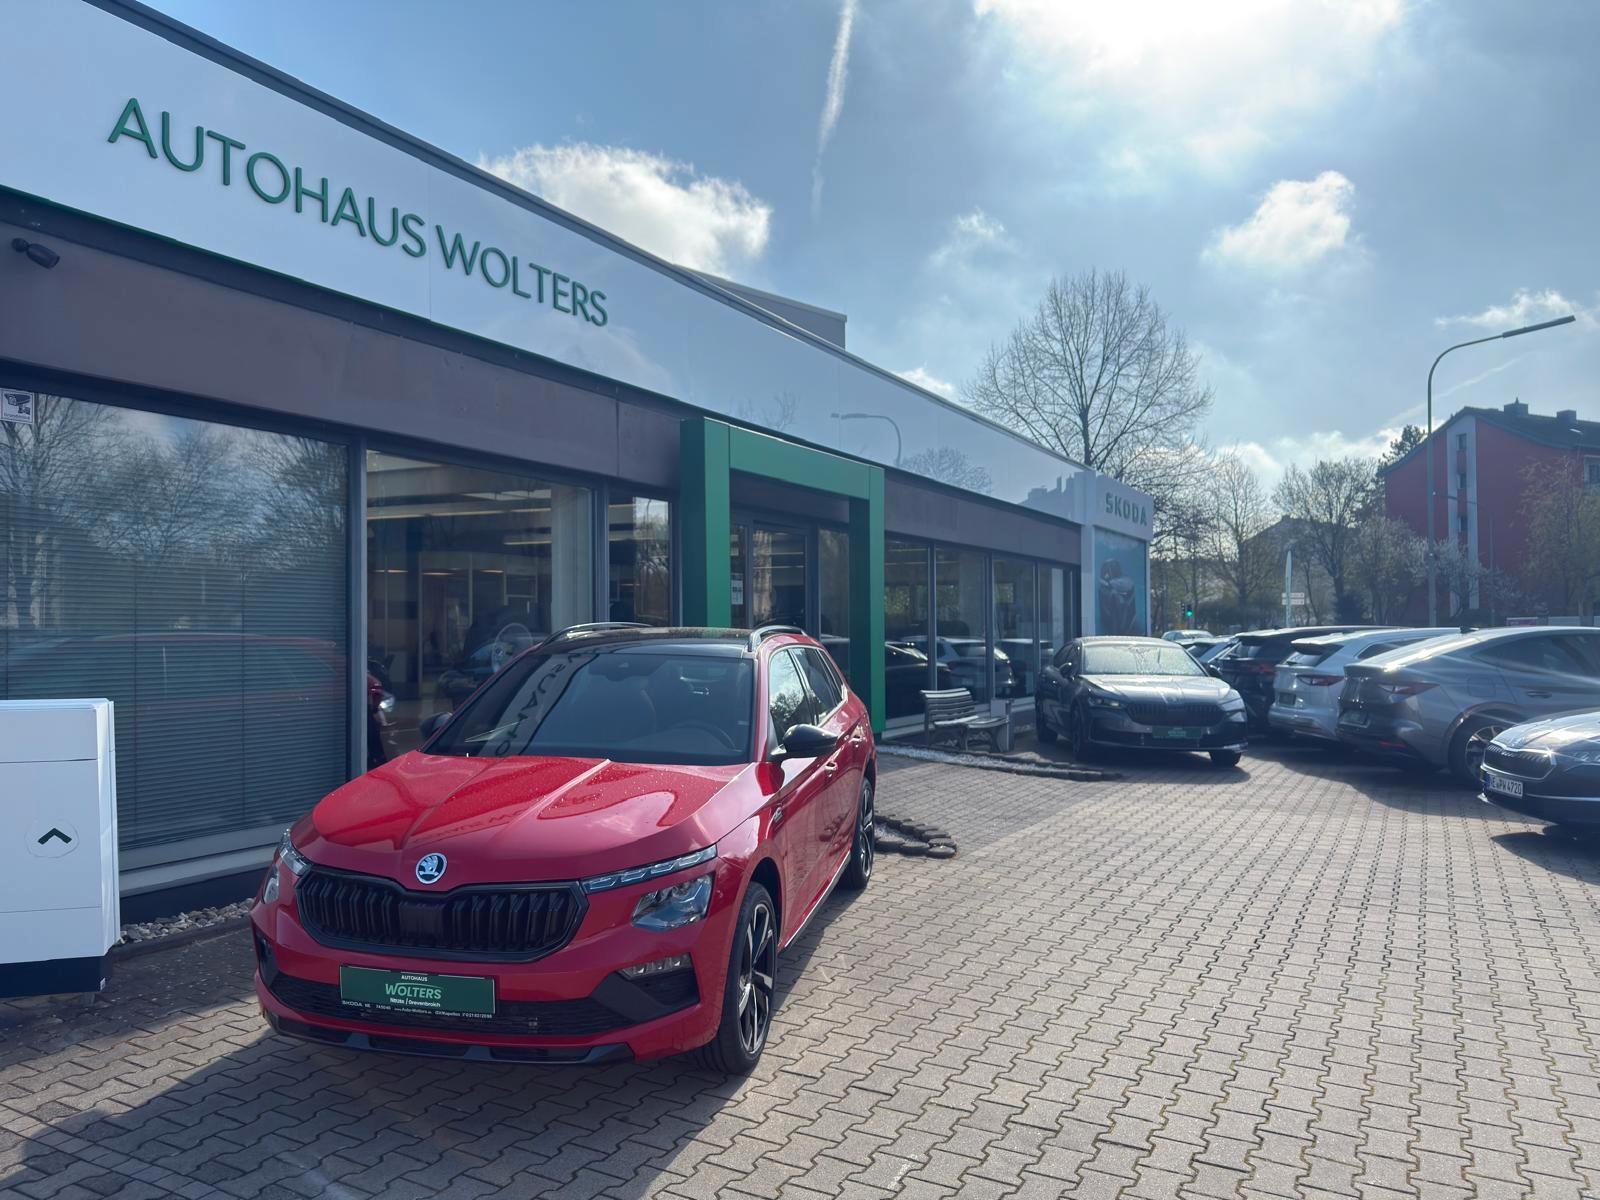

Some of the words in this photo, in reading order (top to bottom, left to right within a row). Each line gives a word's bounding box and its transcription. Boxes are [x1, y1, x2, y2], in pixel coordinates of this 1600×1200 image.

[107, 97, 427, 258] AUTOHAUS
[435, 224, 609, 327] WOLTERS
[401, 974, 428, 982] AUTOHAUS
[385, 982, 442, 1000] WOLTERS
